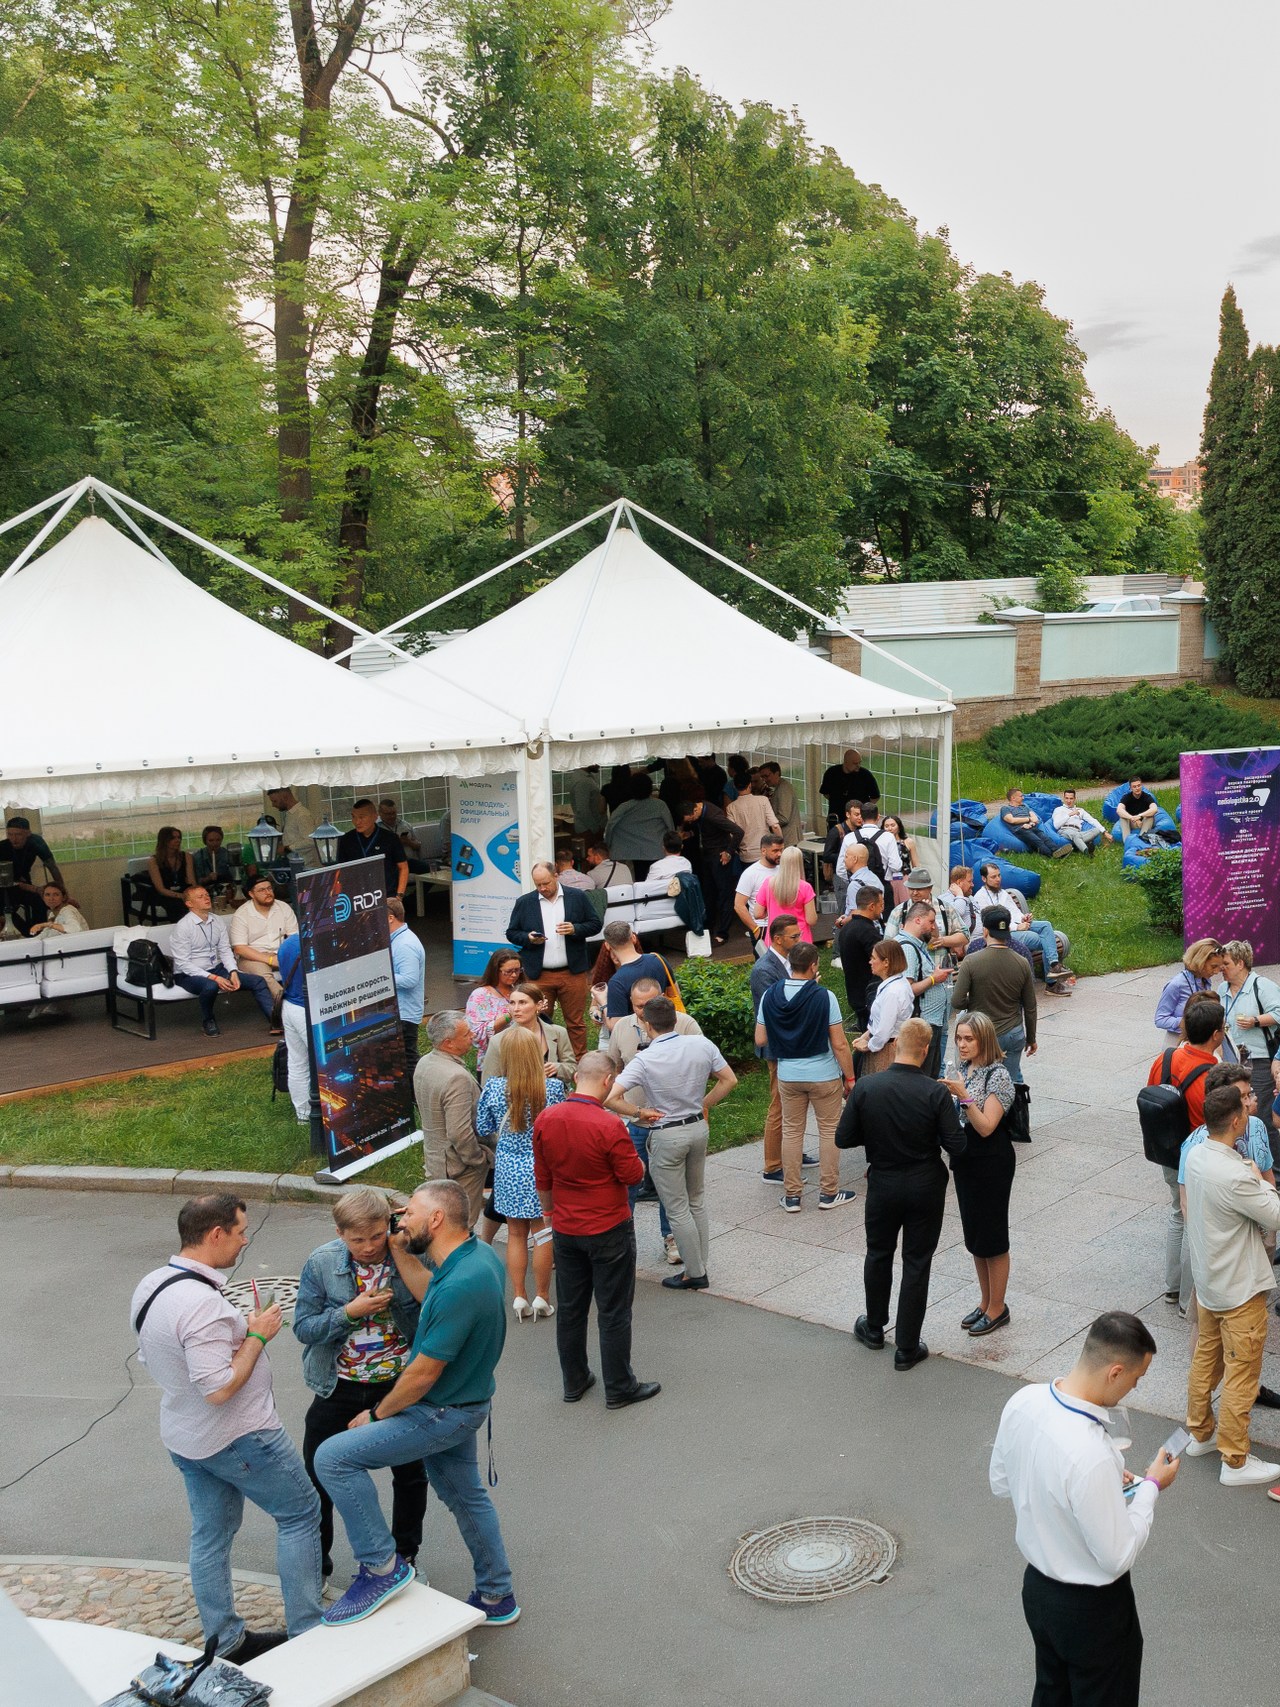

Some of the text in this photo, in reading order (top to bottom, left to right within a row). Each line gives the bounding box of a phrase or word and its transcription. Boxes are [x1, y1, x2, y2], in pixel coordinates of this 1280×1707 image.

[353, 889, 382, 912] RDP
[320, 986, 391, 1016] Надёжные решения.
[324, 975, 390, 1002] Высокая скорость.
